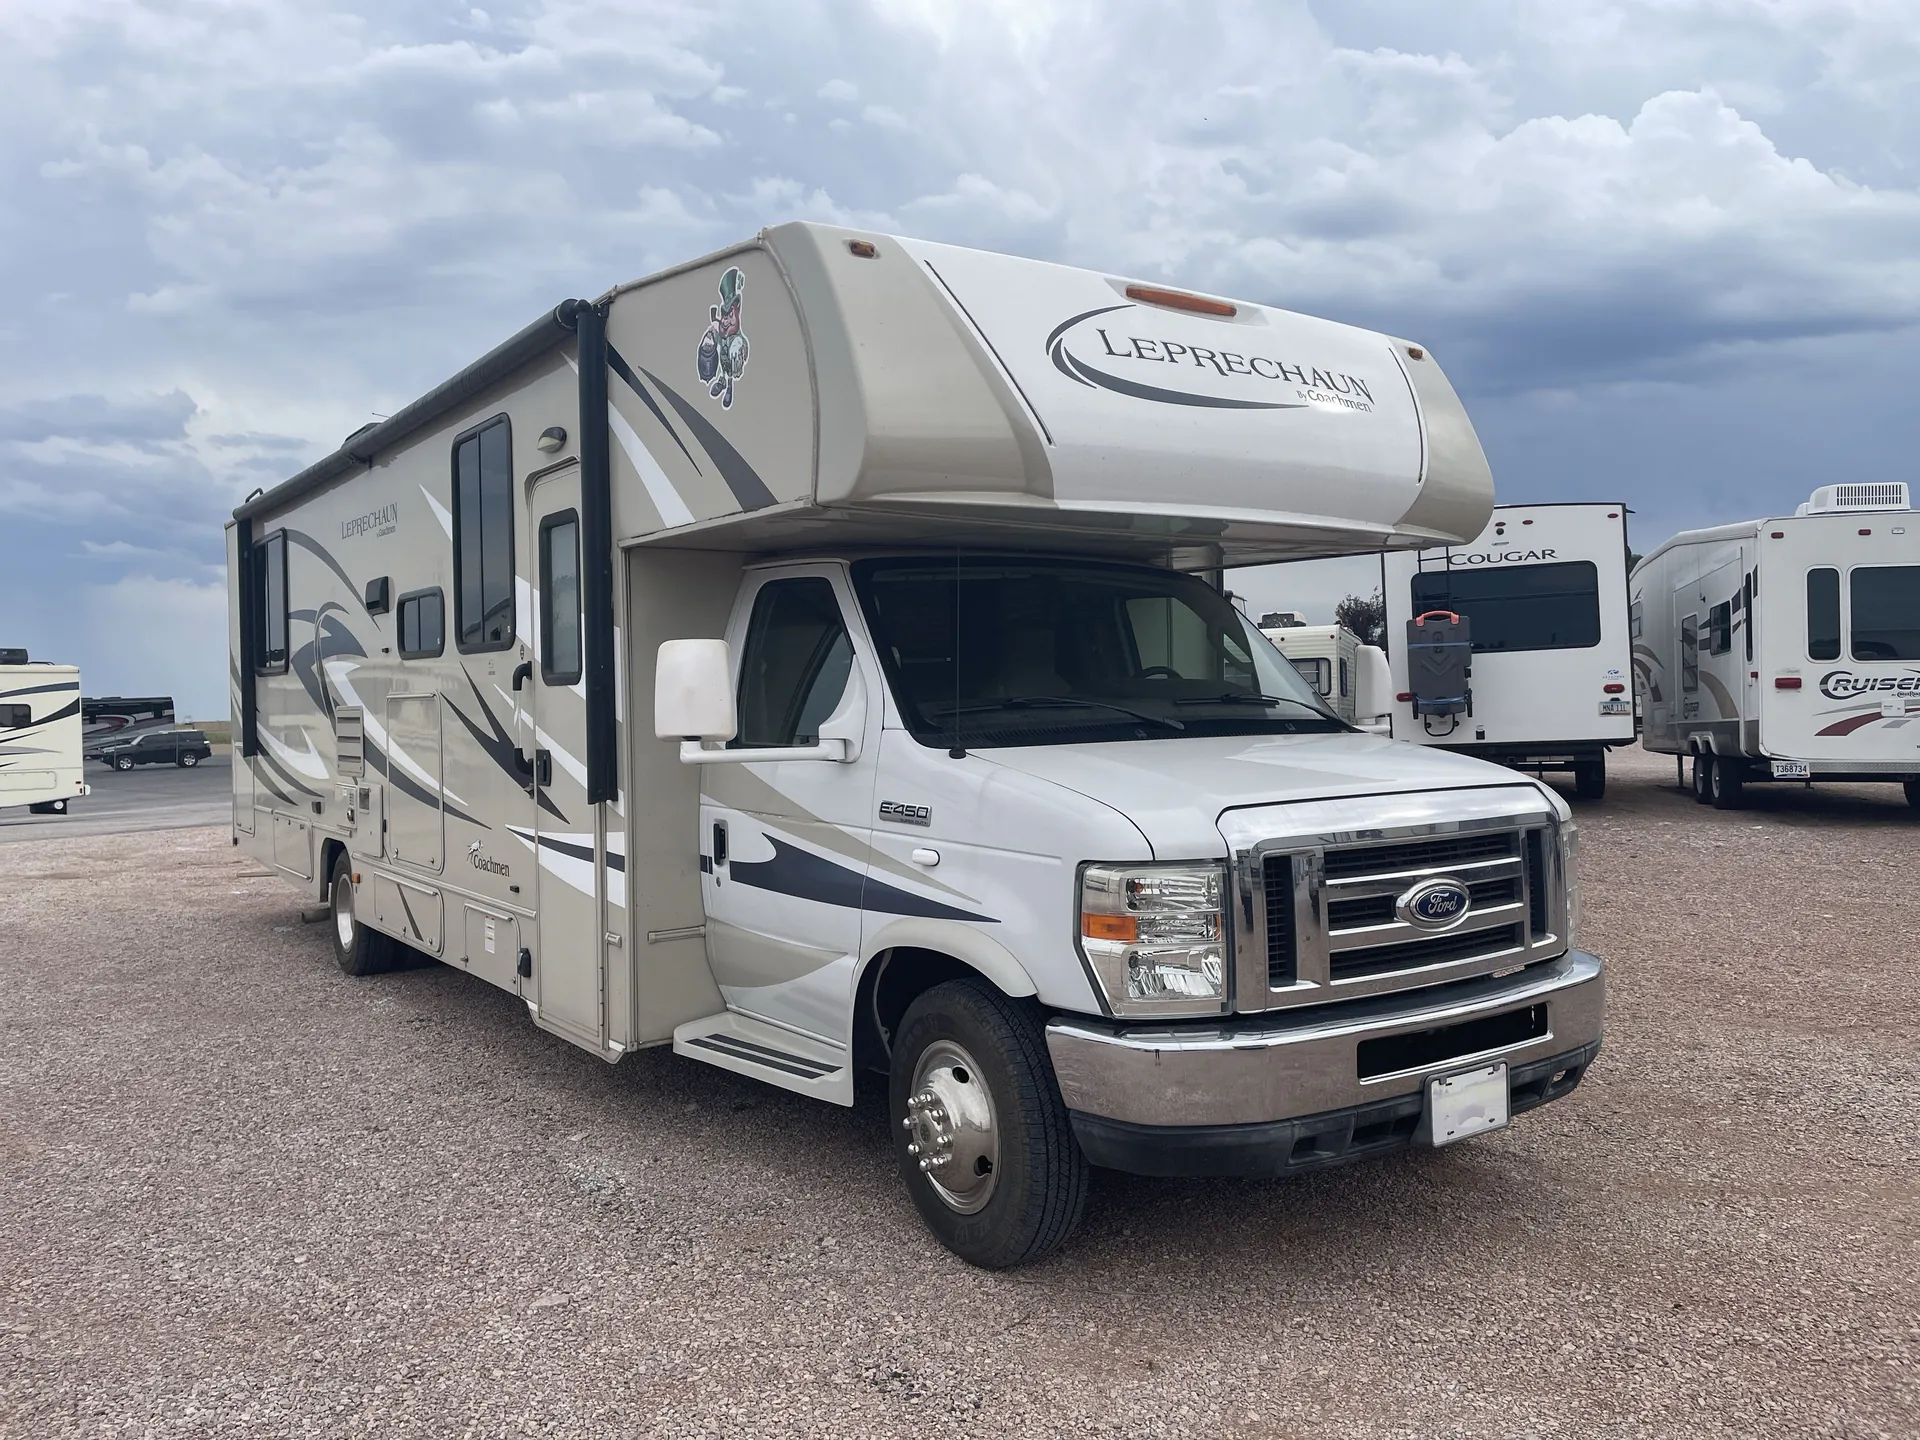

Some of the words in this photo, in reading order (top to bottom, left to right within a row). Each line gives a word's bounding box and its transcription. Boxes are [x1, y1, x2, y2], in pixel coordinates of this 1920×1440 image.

[1096, 328, 1375, 405] LEPRECHAUN
[1296, 390, 1308, 401] By
[1307, 389, 1373, 413] Coachmen
[341, 502, 398, 540] LEPRECHAUN
[1449, 548, 1558, 566] COUGAR
[1775, 764, 1807, 773] T368734
[473, 854, 510, 878] Coachmen
[1428, 892, 1458, 914] Ford
